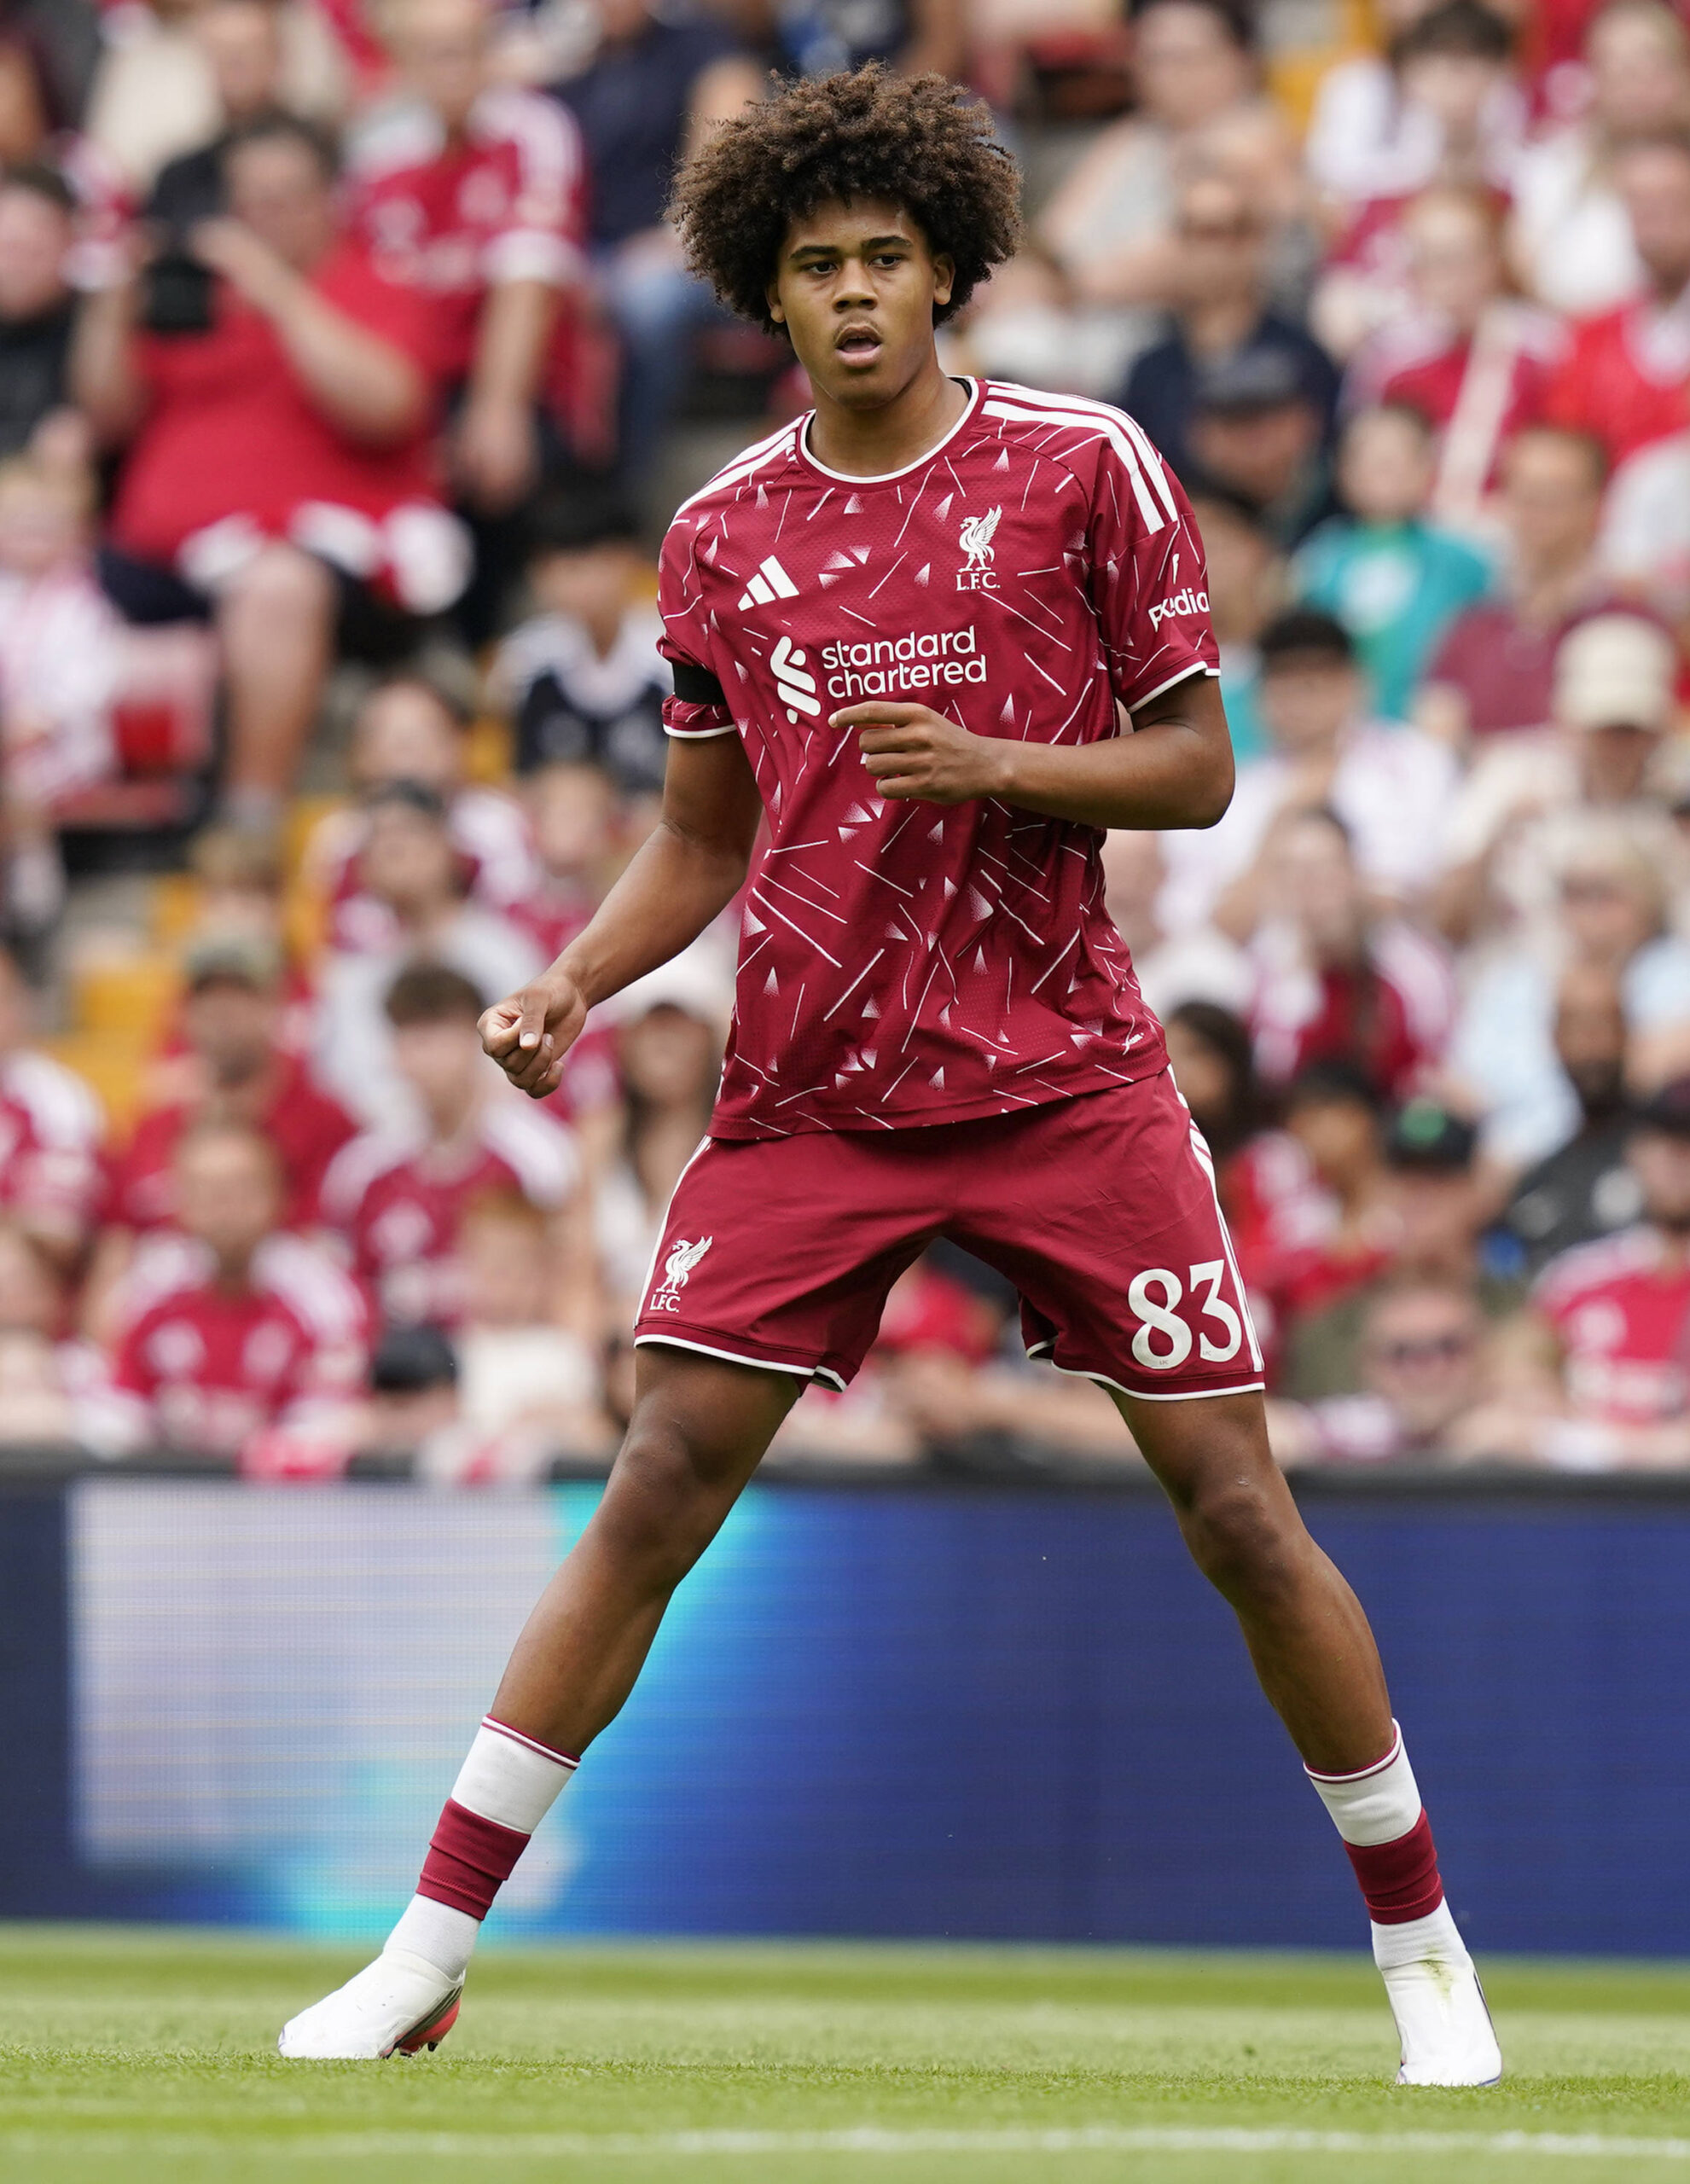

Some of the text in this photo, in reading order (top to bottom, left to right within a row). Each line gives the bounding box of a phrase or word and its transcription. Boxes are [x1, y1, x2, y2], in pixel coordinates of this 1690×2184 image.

[955, 572, 1001, 591] L.F.C.
[822, 624, 976, 670] standard
[828, 653, 987, 699] chartered
[1128, 1259, 1242, 1370] 83
